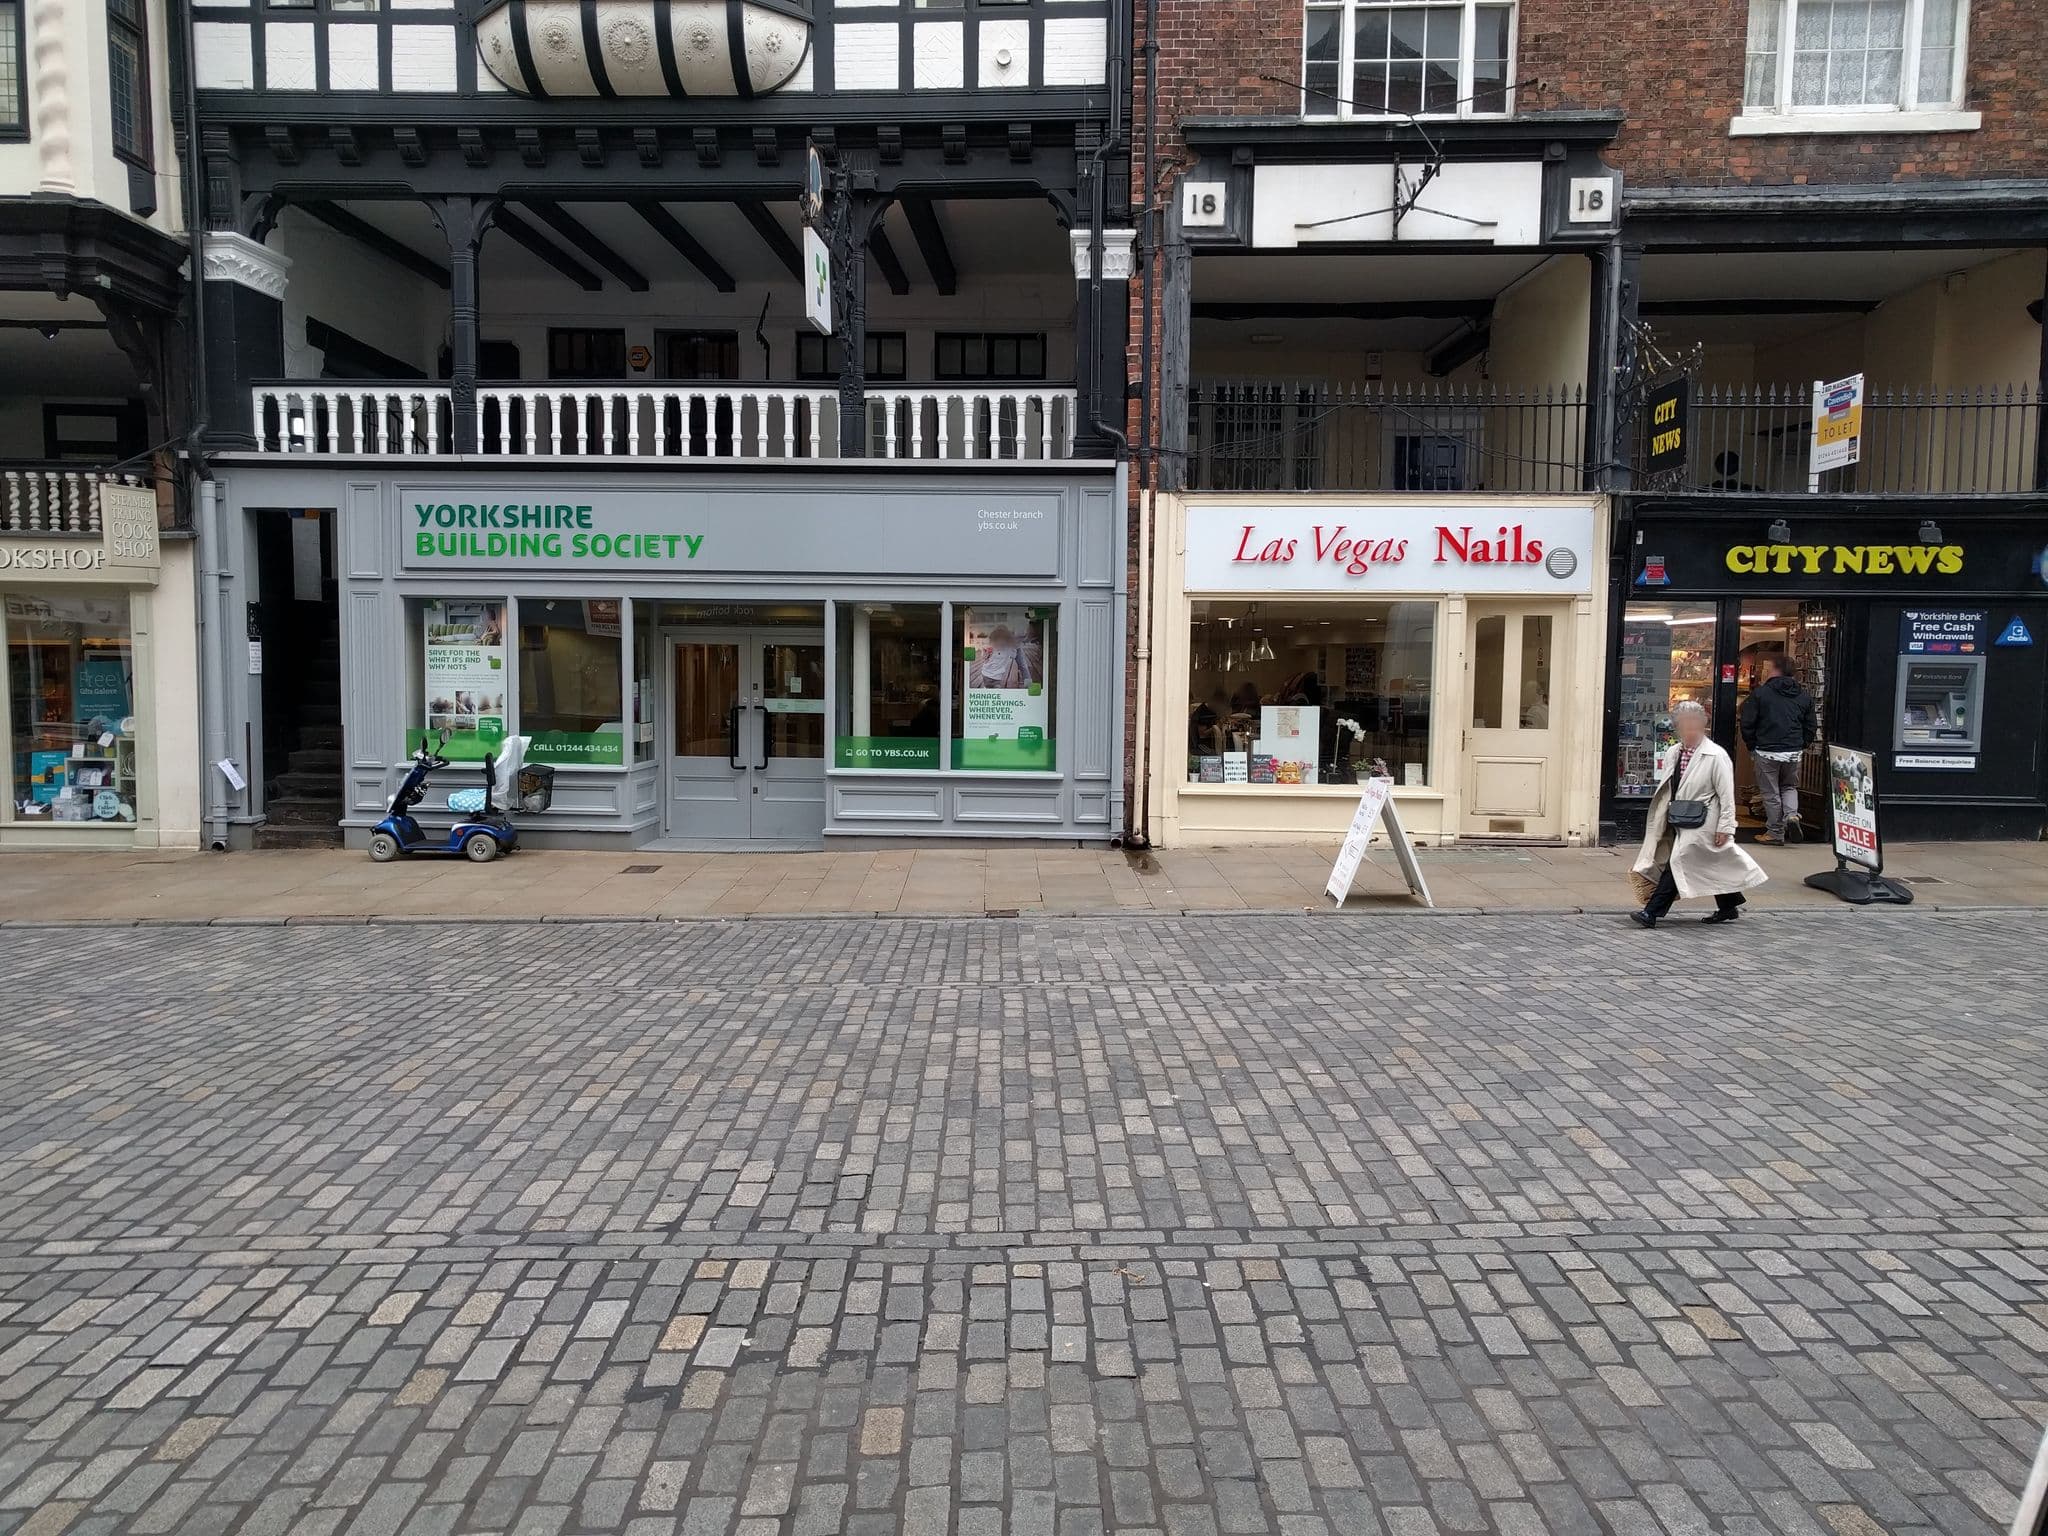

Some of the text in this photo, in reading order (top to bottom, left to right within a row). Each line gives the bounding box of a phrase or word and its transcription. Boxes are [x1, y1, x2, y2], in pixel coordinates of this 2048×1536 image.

[1190, 194, 1217, 215] 18
[1578, 190, 1604, 211] 18
[1654, 397, 1678, 425] CITY
[1823, 421, 1854, 440] TO LET
[1651, 427, 1681, 457] NEWS
[111, 494, 151, 509] STEAMER
[112, 507, 152, 522] TRADING
[414, 504, 594, 529] YORKSHIRE
[977, 509, 1044, 519] Chester branch
[112, 521, 153, 541] COOK
[977, 521, 1019, 531] ybs.co.uk
[113, 540, 154, 558] SHOP
[416, 533, 704, 558] BUILDING SOCIETY
[1231, 524, 1544, 576] Las Vegas Nails
[1725, 545, 1965, 575] CITY NEWS
[1919, 612, 1982, 621] Yorkshire Bank
[1912, 622, 1975, 631] Free Cash
[1912, 632, 1974, 640] Withdrawals
[556, 744, 583, 752] 01244
[884, 749, 929, 757] YBS.CO.UK
[1841, 825, 1871, 846] SALE
